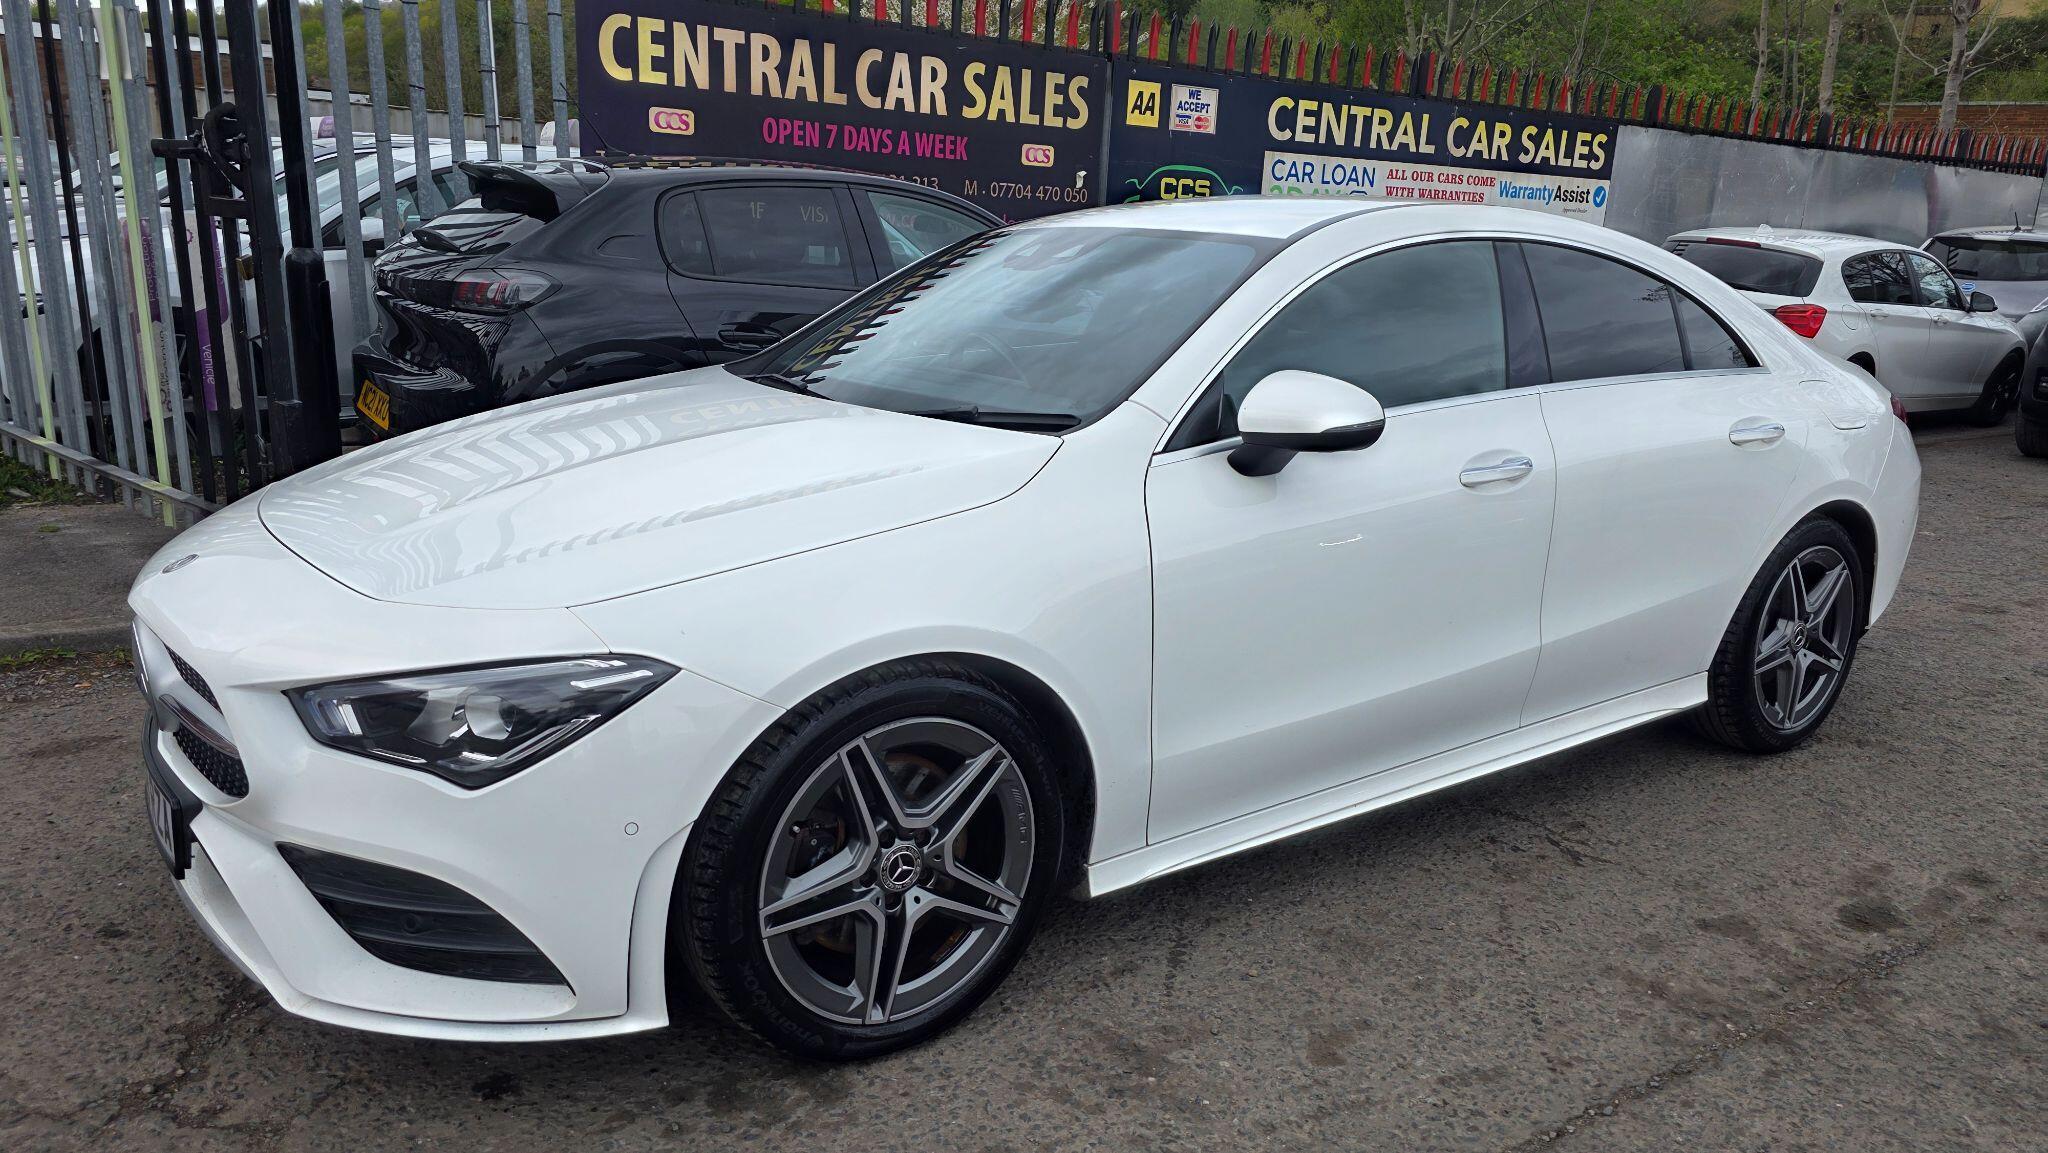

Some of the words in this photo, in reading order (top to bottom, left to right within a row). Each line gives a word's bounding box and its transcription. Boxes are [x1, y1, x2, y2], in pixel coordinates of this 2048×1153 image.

[598, 13, 847, 105] CENTRAL
[855, 48, 948, 116] CAR
[961, 61, 1089, 130] SALES
[1130, 90, 1155, 116] AA
[1188, 89, 1201, 100] WE
[1177, 101, 1210, 113] ACCEPT
[654, 111, 690, 131] CCS
[762, 117, 819, 148] OPEN
[826, 124, 838, 149] 7
[843, 125, 893, 154] DAYS
[897, 131, 911, 156] A
[915, 132, 969, 160] WEEK
[1267, 96, 1435, 154] CENTRAL
[1447, 116, 1512, 161] CAR
[1518, 125, 1608, 171] SALES
[1025, 147, 1050, 164] CCS
[1271, 159, 1315, 183] CAR
[1321, 163, 1376, 188] LOAN
[1386, 169, 1407, 181] ALL
[1411, 170, 1434, 182] OUR
[1437, 172, 1464, 185] CARS
[1466, 175, 1496, 187] COME
[990, 181, 1032, 199] 07704
[1035, 185, 1060, 201] 470
[1064, 187, 1088, 203] 050
[1160, 177, 1211, 200] CCS
[1385, 186, 1415, 198] WITH
[1418, 188, 1484, 203] WARRANTIES
[1500, 181, 1590, 206] WarrantyAssist
